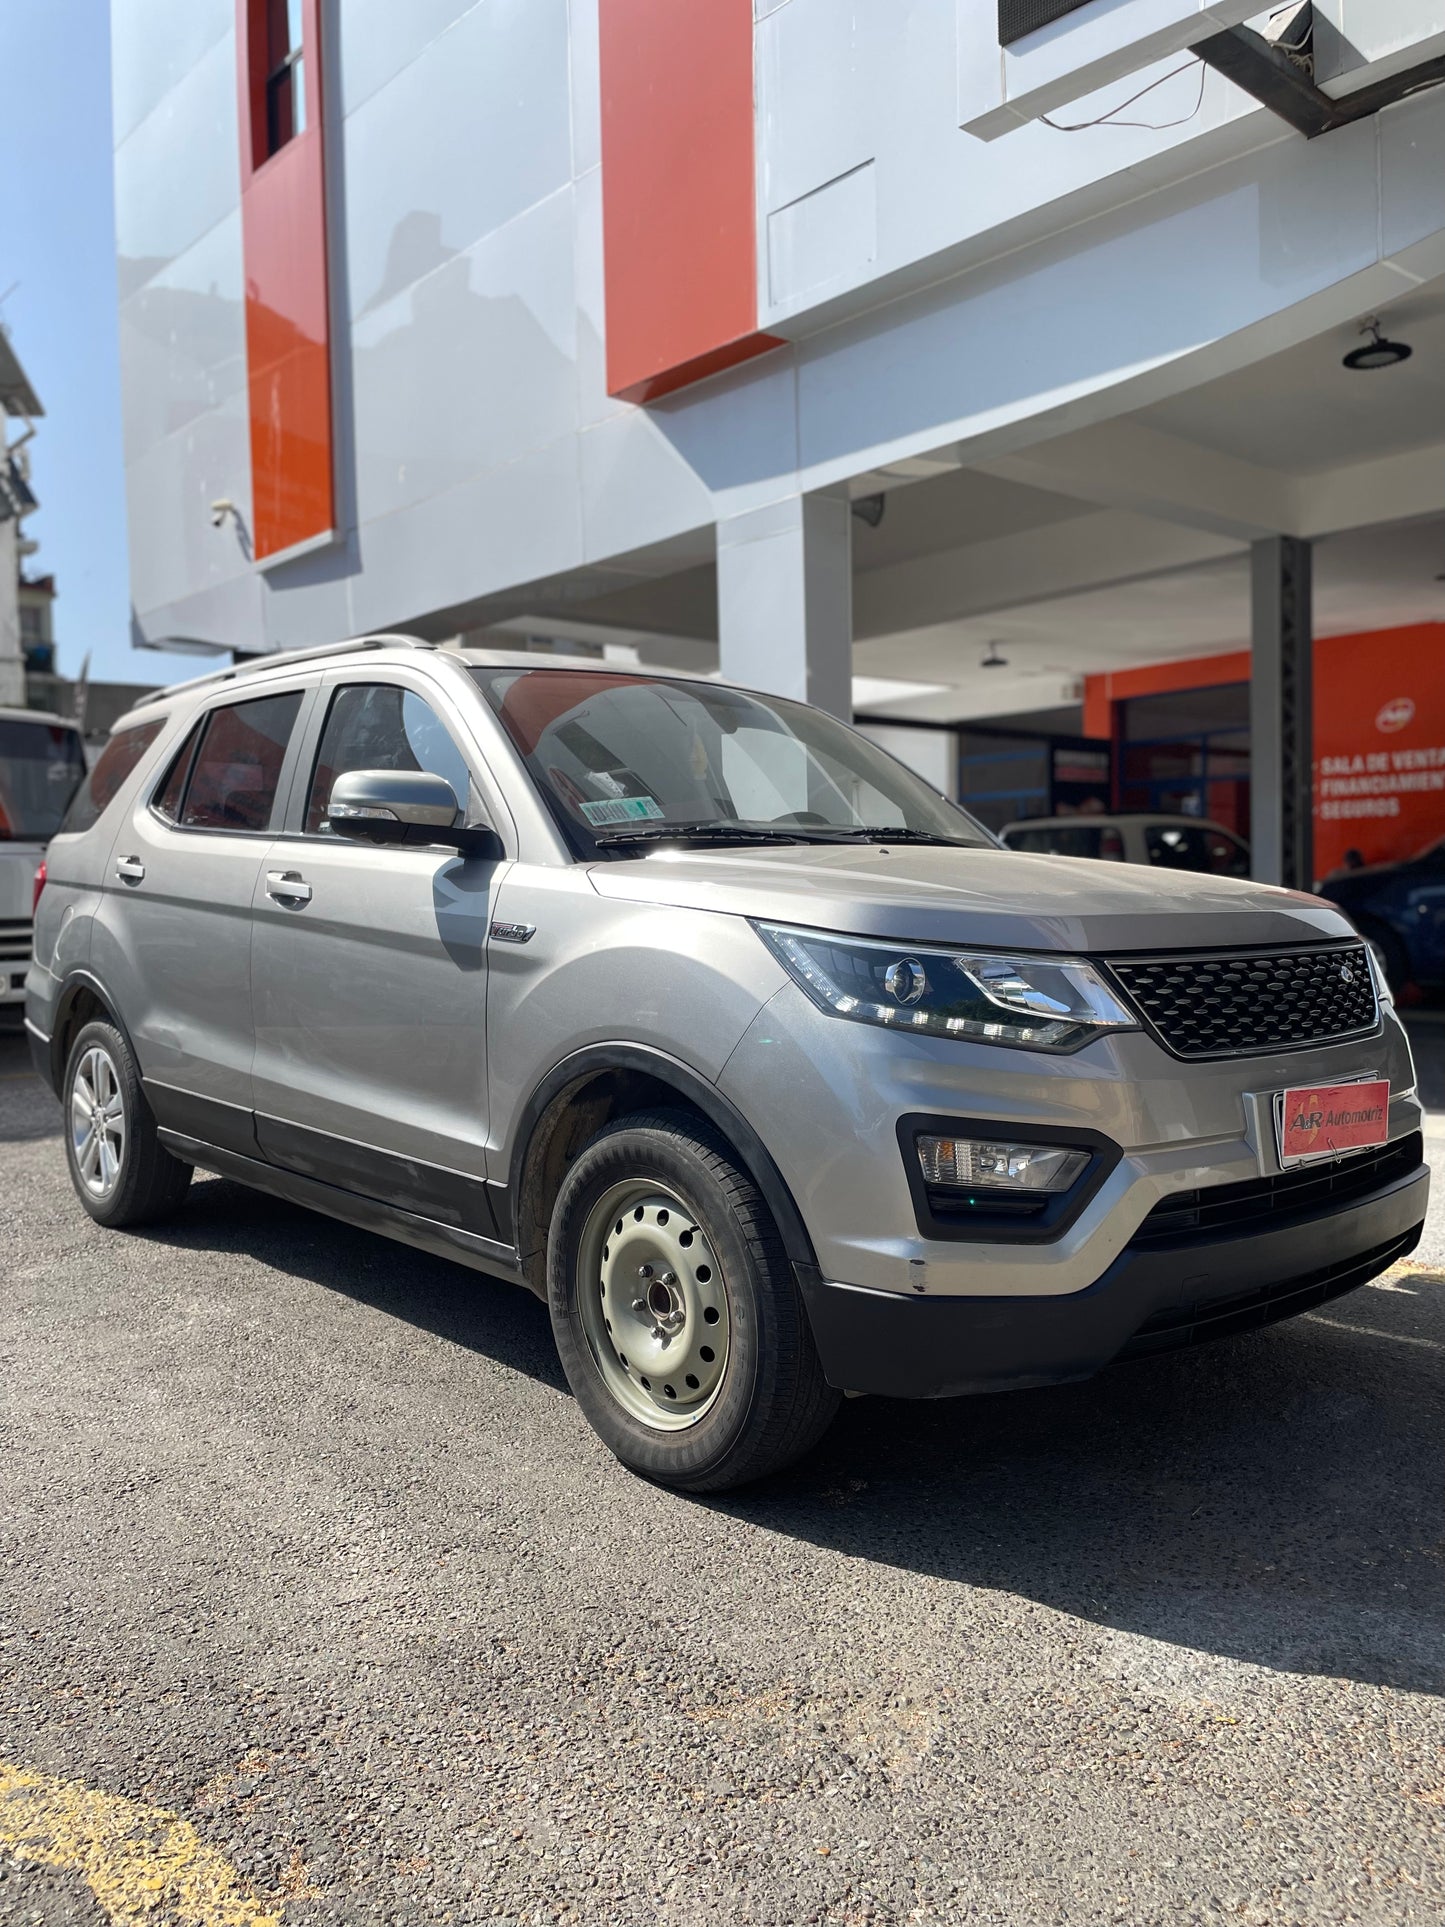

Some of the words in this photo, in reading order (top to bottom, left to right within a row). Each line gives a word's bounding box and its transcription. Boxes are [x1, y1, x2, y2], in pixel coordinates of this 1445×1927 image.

[1321, 755, 1365, 775] SALA
[1366, 752, 1389, 773] DE
[1321, 798, 1400, 819] SEGUROS
[1290, 1112, 1323, 1132] A&R
[1326, 1106, 1383, 1127] Automotriz
